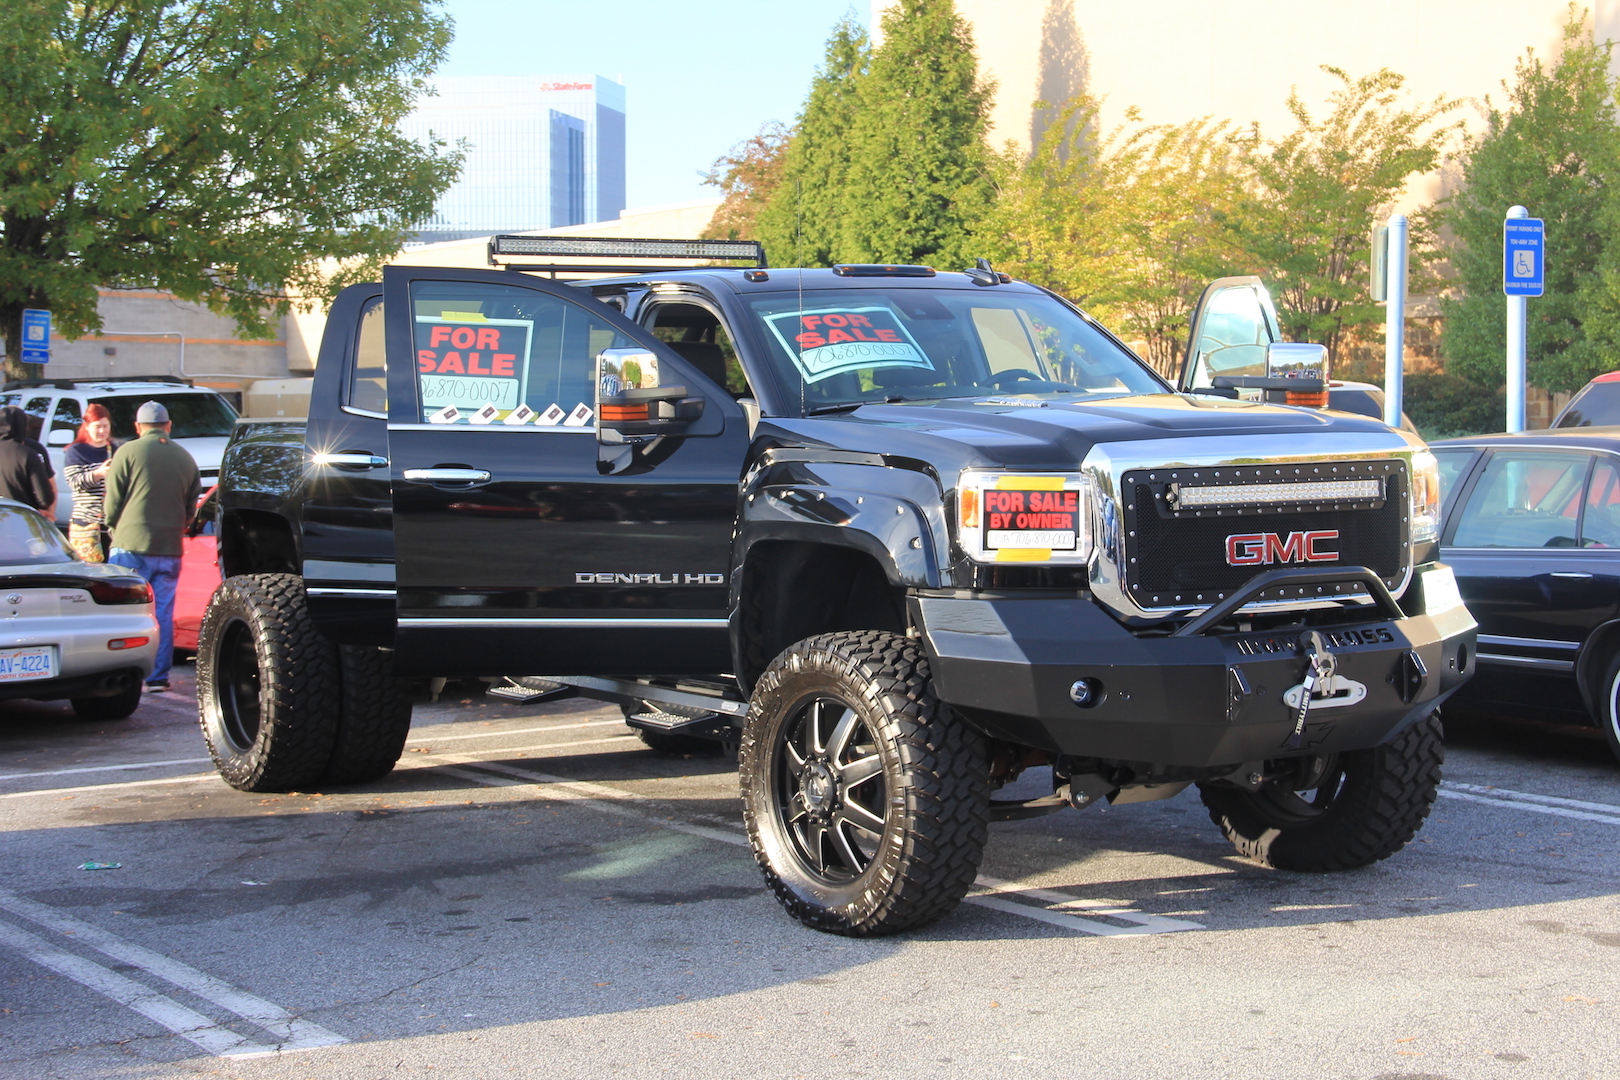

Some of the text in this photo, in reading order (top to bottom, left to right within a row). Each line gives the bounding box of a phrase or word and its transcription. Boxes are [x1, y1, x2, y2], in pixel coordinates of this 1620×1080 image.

[801, 313, 874, 331] FOR
[430, 326, 501, 350] FOR
[795, 328, 903, 349] SALE
[418, 349, 516, 376] SALE
[804, 343, 913, 368] 706-870-0007
[985, 492, 1078, 513] FOR SALE
[990, 513, 1073, 529] BY OWNER
[1225, 530, 1340, 566] GMC
[575, 572, 724, 584] DENALI HD
[1309, 627, 1394, 650] ROSS
[1294, 691, 1310, 736] SMITTYBILT
